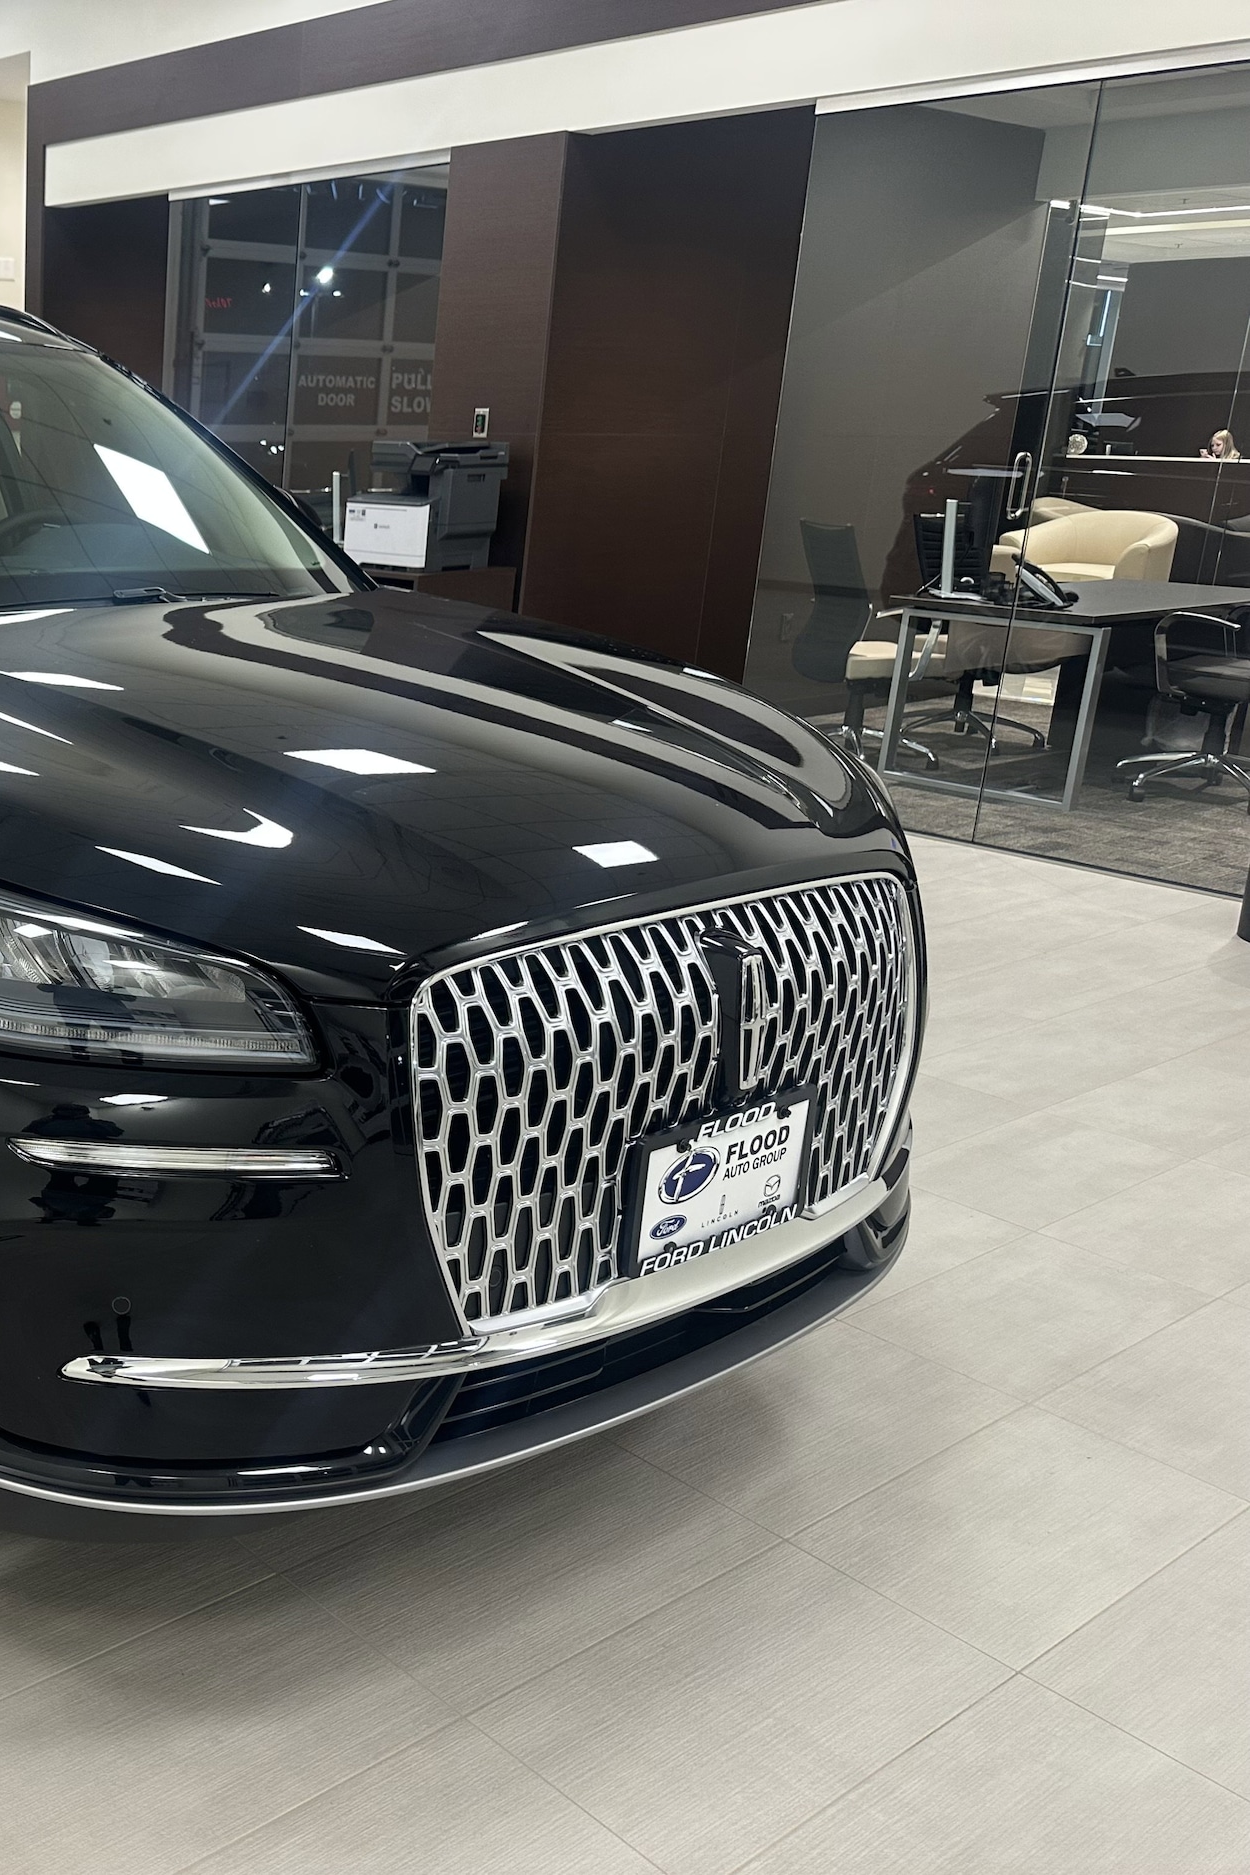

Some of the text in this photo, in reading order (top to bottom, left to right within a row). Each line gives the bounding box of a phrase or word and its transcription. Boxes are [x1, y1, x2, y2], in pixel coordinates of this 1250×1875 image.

[297, 374, 376, 390] AUTOMATIC
[317, 393, 356, 407] DOOR
[697, 1102, 777, 1140] FLOOD
[725, 1125, 791, 1165] FLOOD
[722, 1147, 787, 1181] AUTO GROUP
[701, 1210, 739, 1228] LINCOLN
[640, 1204, 798, 1276] FORD LINCOLN
